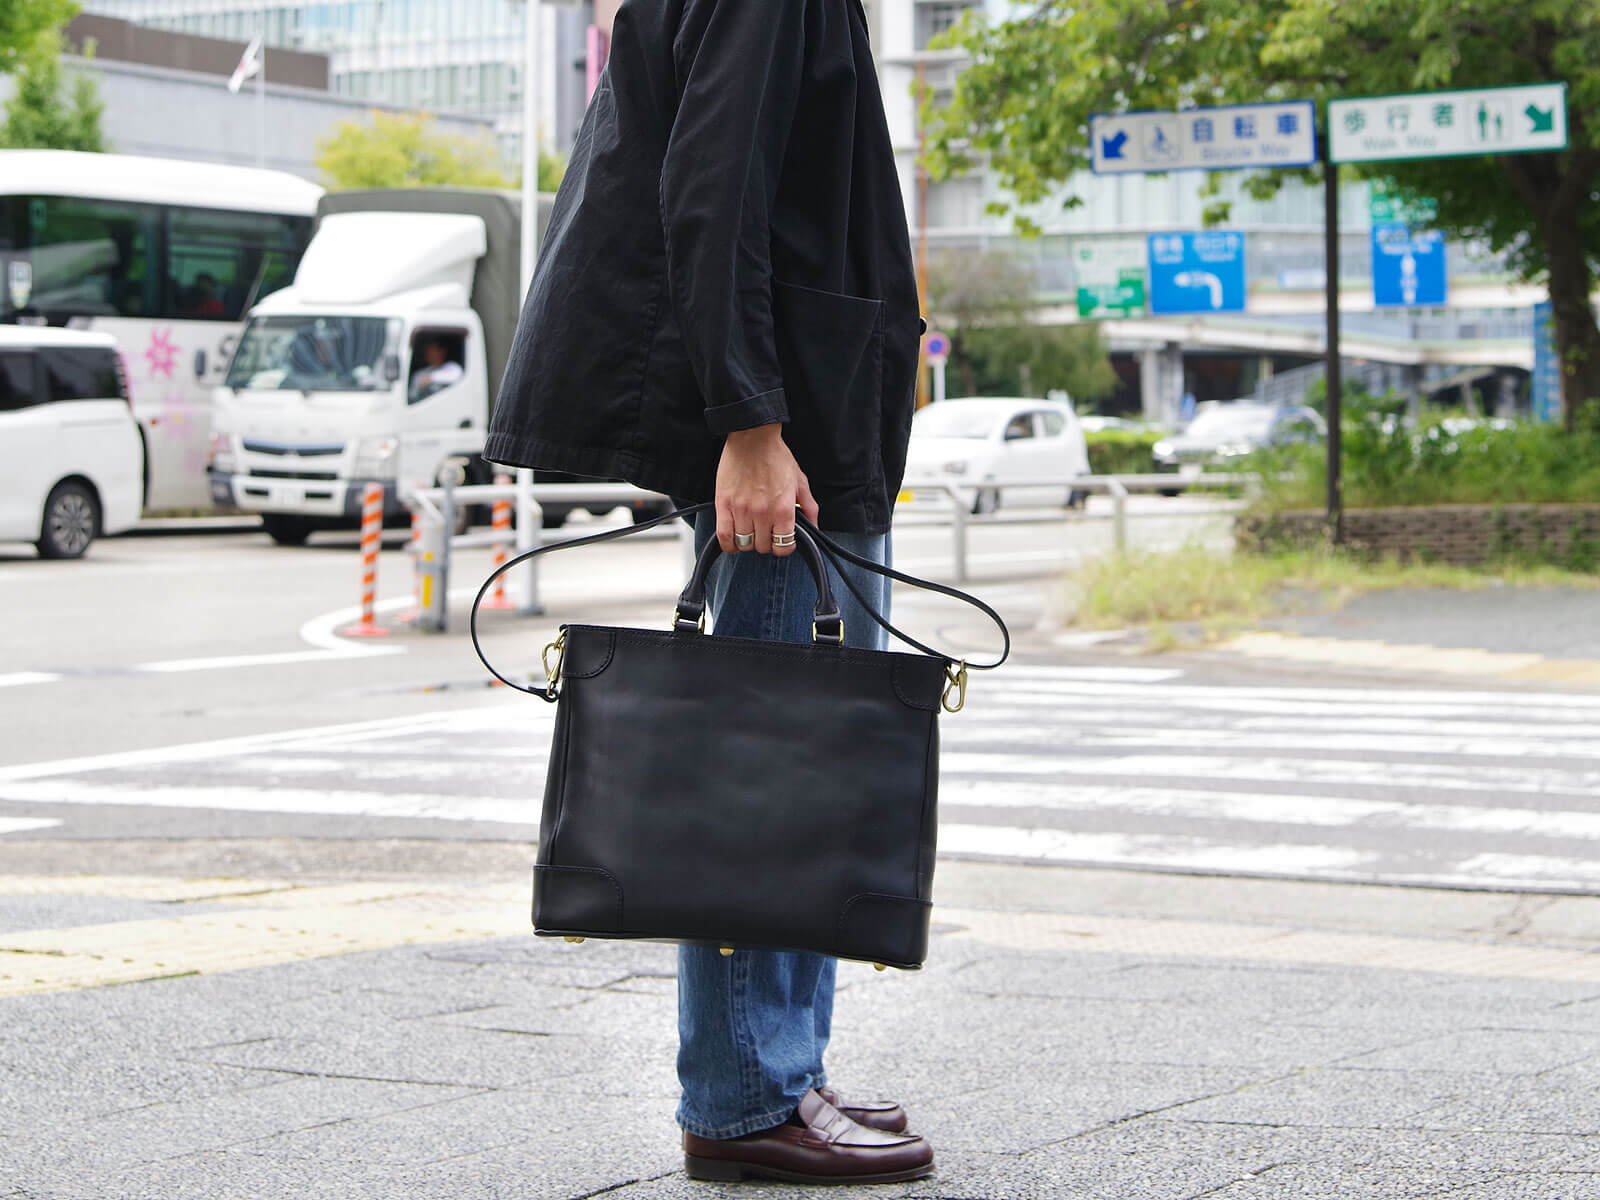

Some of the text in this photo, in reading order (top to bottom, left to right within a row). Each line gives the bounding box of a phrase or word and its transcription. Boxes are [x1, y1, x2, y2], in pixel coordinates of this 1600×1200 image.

[1193, 114, 1298, 142] 自転車
[1343, 102, 1454, 134] 歩行者
